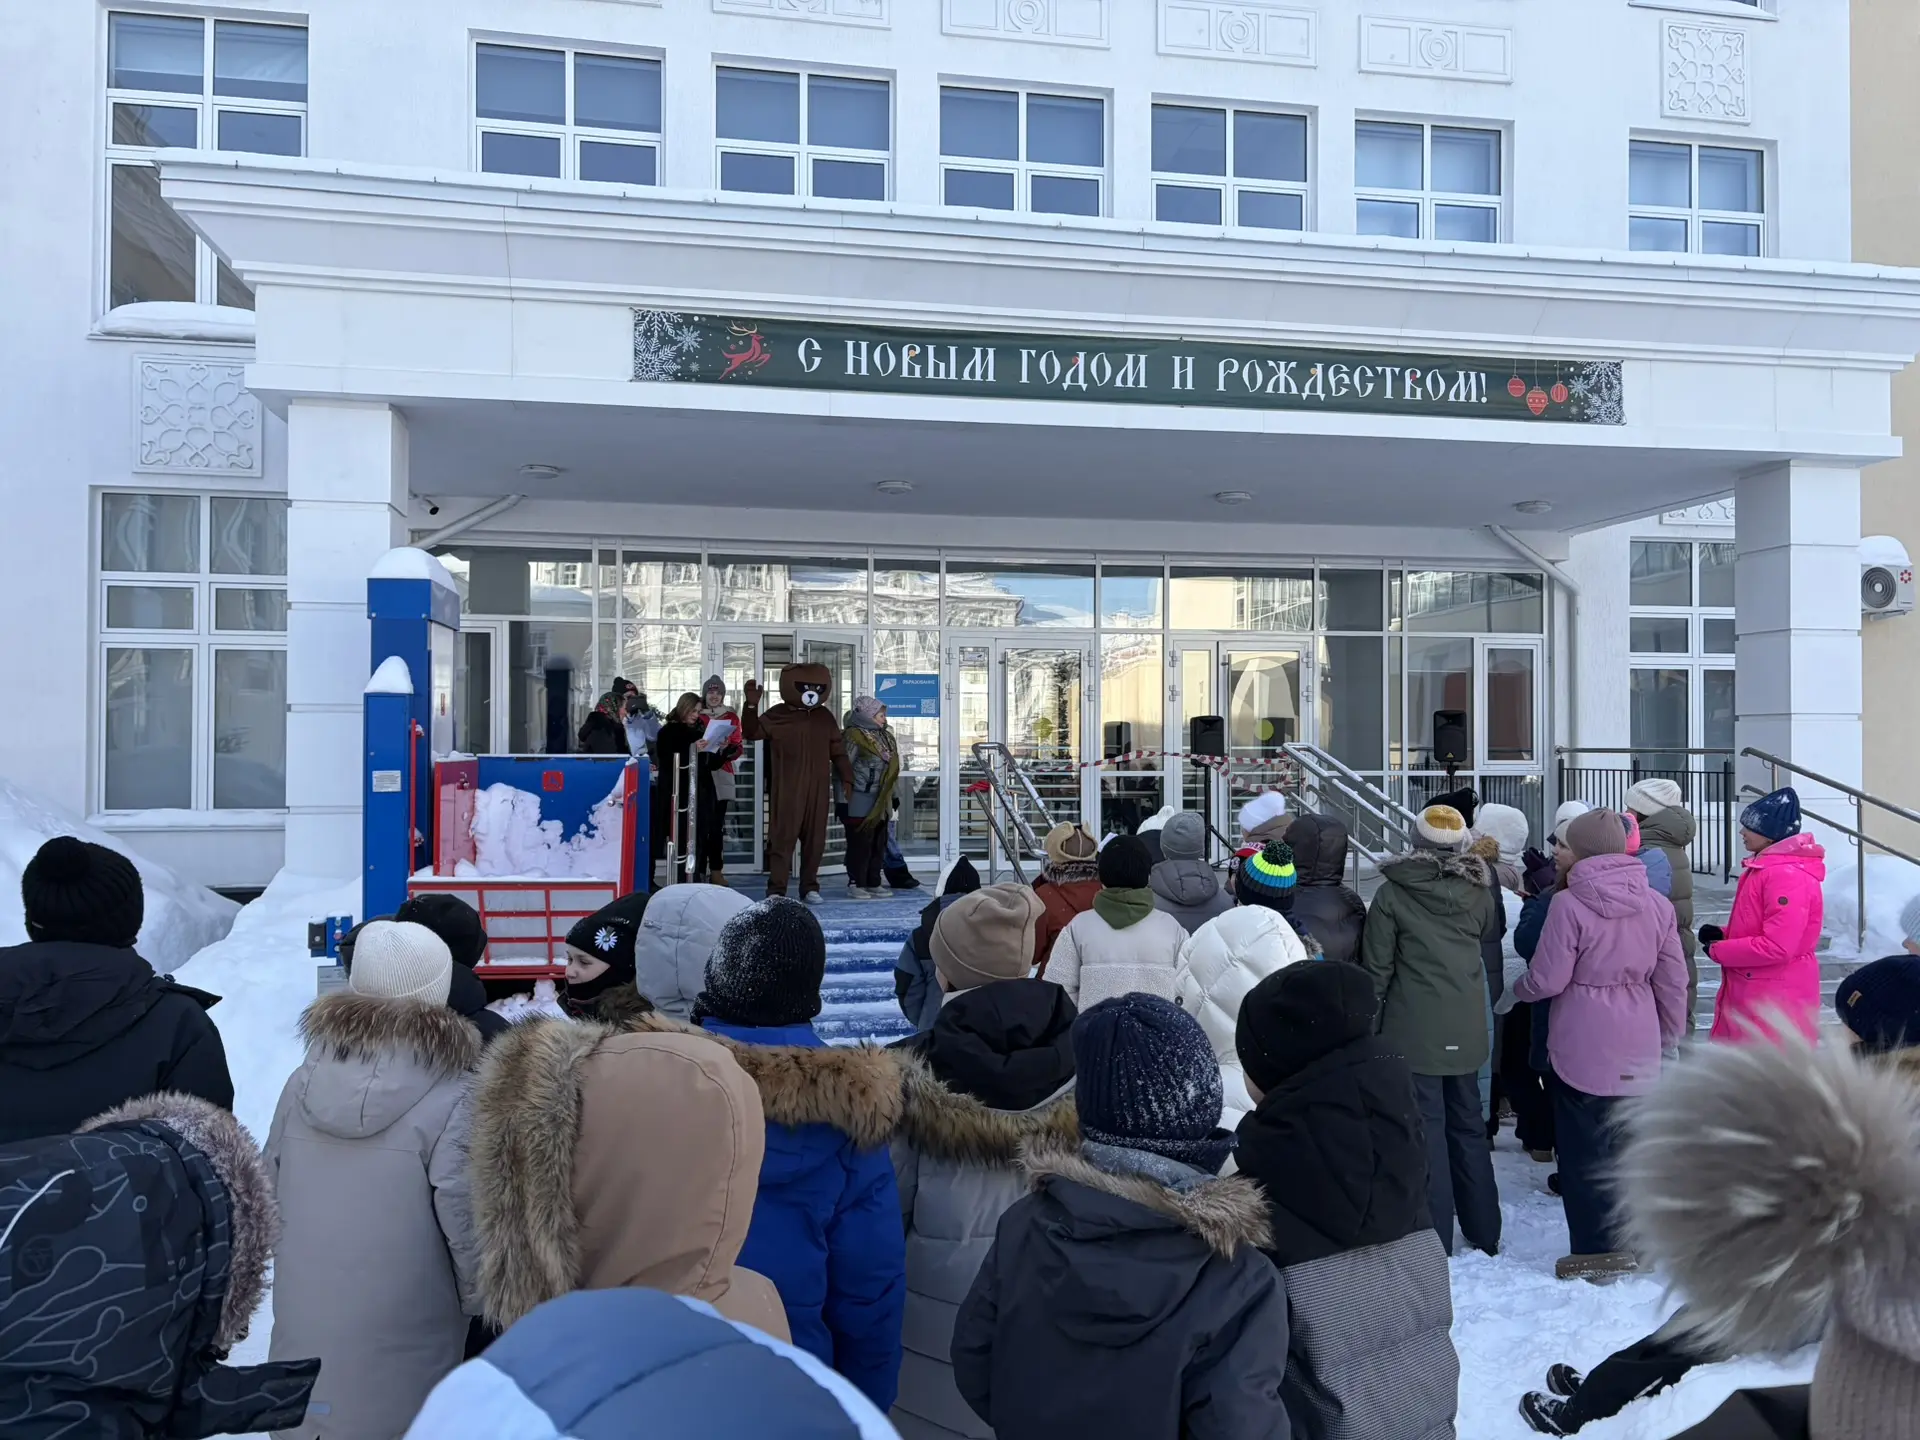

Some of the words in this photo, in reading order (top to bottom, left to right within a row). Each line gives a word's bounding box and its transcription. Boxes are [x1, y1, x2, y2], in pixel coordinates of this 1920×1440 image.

[797, 337, 822, 373] С
[844, 340, 997, 382] НОВЫМ
[1019, 349, 1148, 392] ГОДОМ
[1172, 355, 1195, 390] И
[1216, 358, 1488, 404] РОЖДЕСТВОМ!
